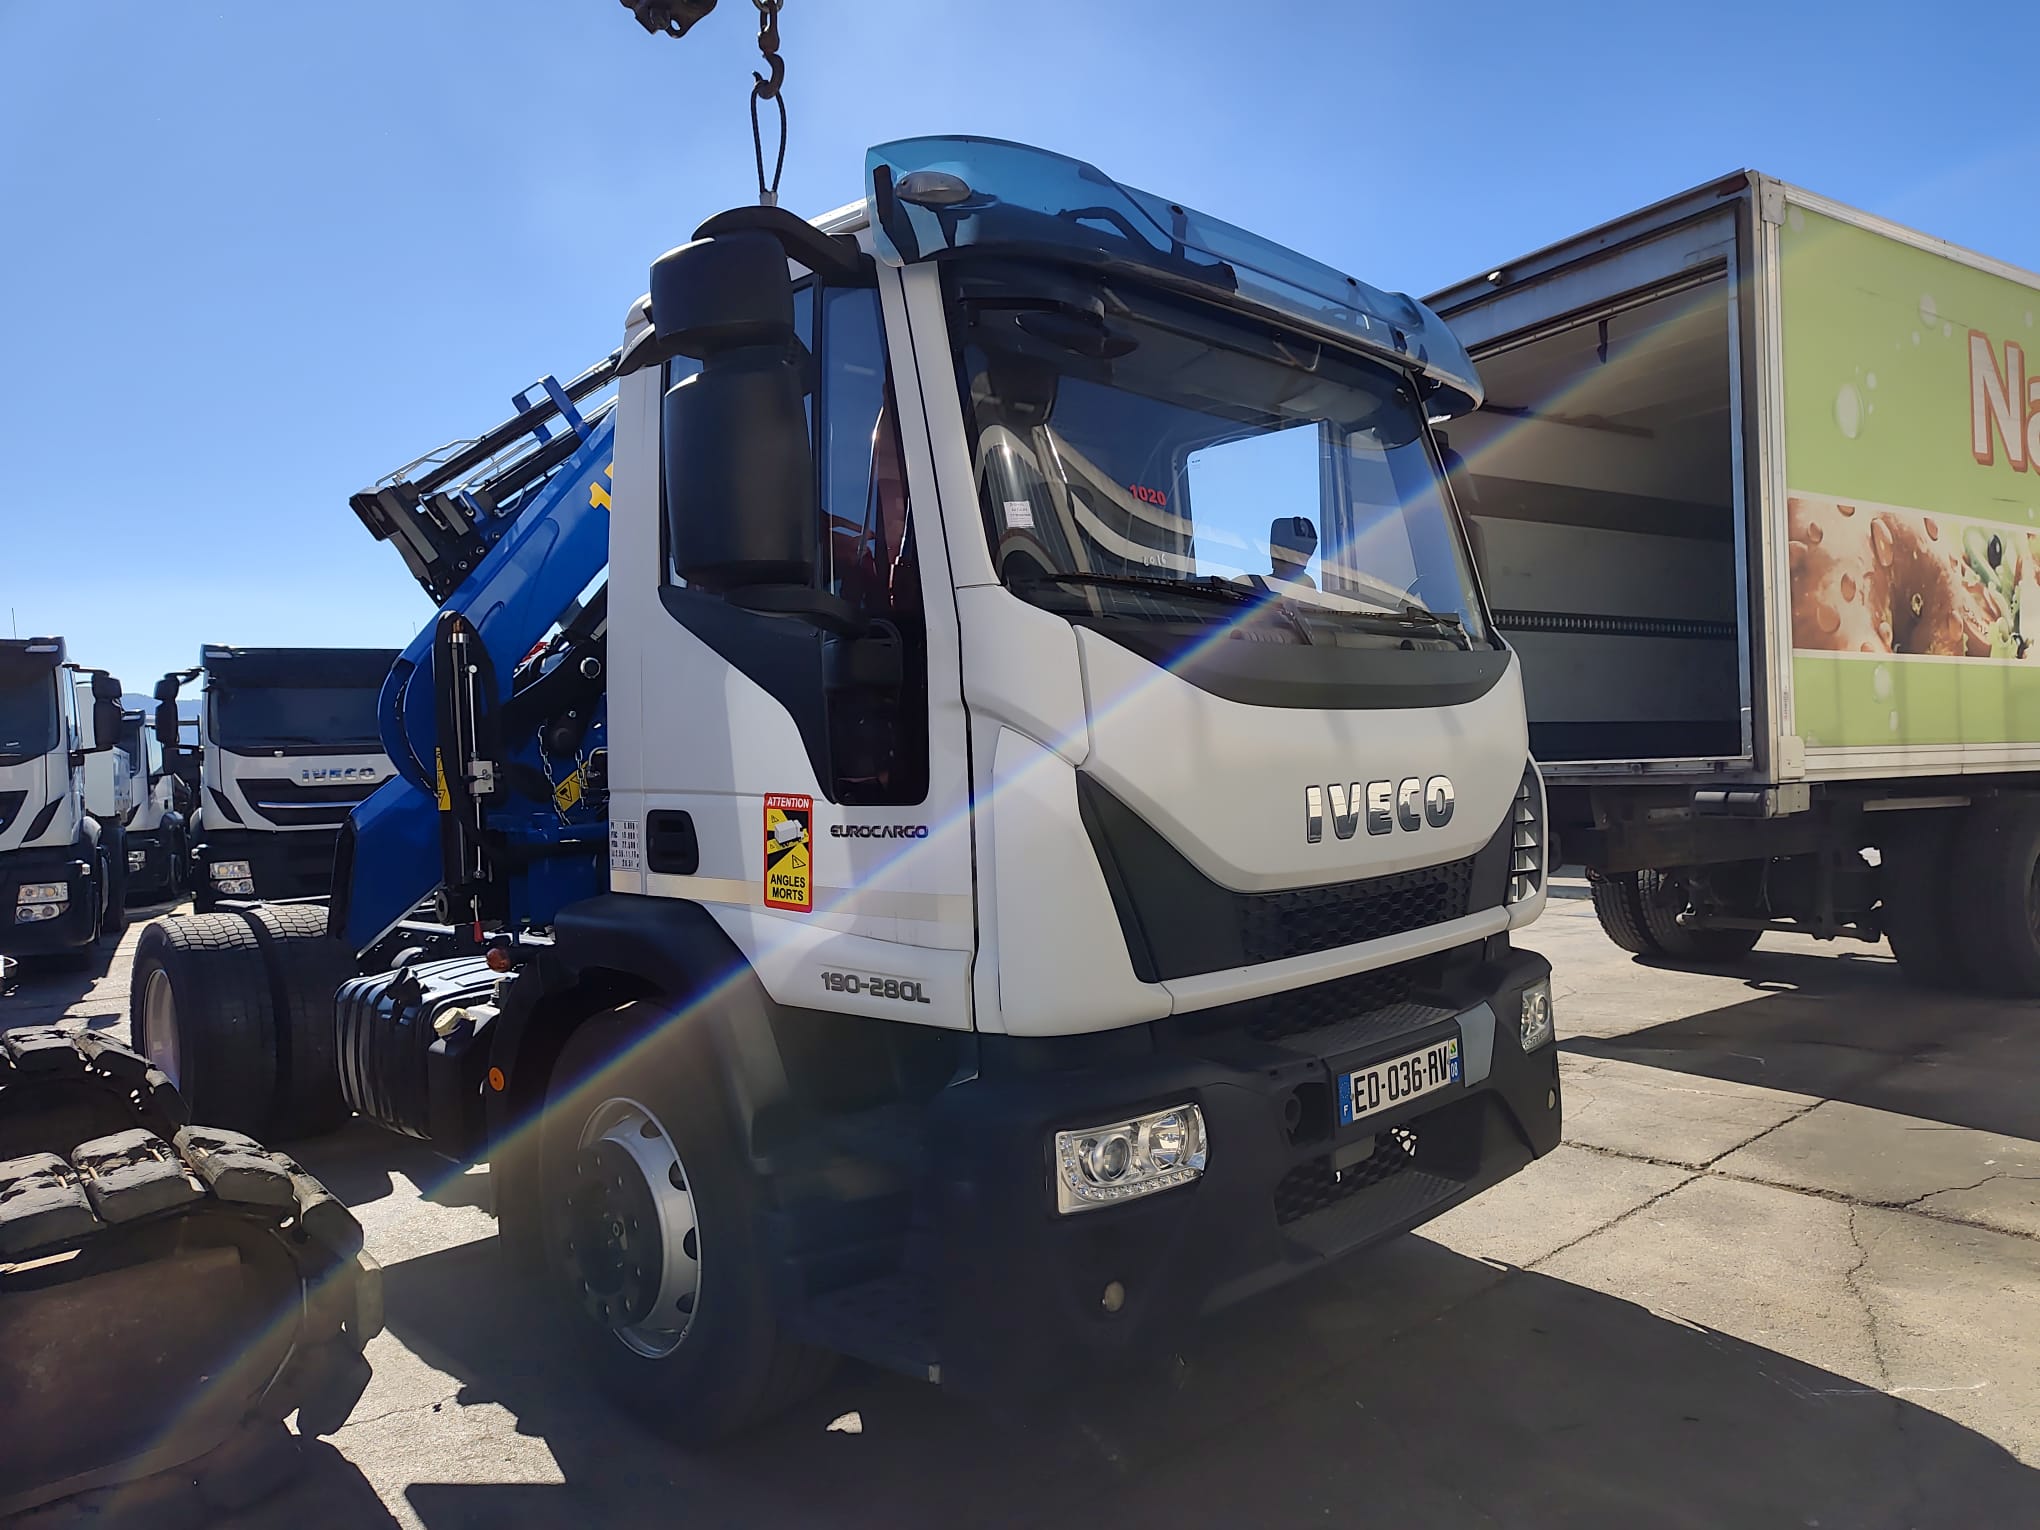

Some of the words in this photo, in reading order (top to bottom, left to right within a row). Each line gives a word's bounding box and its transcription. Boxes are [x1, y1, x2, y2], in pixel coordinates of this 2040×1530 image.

[1129, 484, 1167, 506] 1020
[302, 767, 376, 783] IVECO
[767, 796, 810, 809] ATTENTION
[1305, 775, 1455, 843] IVECO
[830, 825, 929, 839] EUROCARGO
[770, 873, 806, 888] ANGLES
[772, 887, 804, 901] MORTS
[821, 972, 931, 1004] 190-280L
[1343, 1105, 1349, 1117] F
